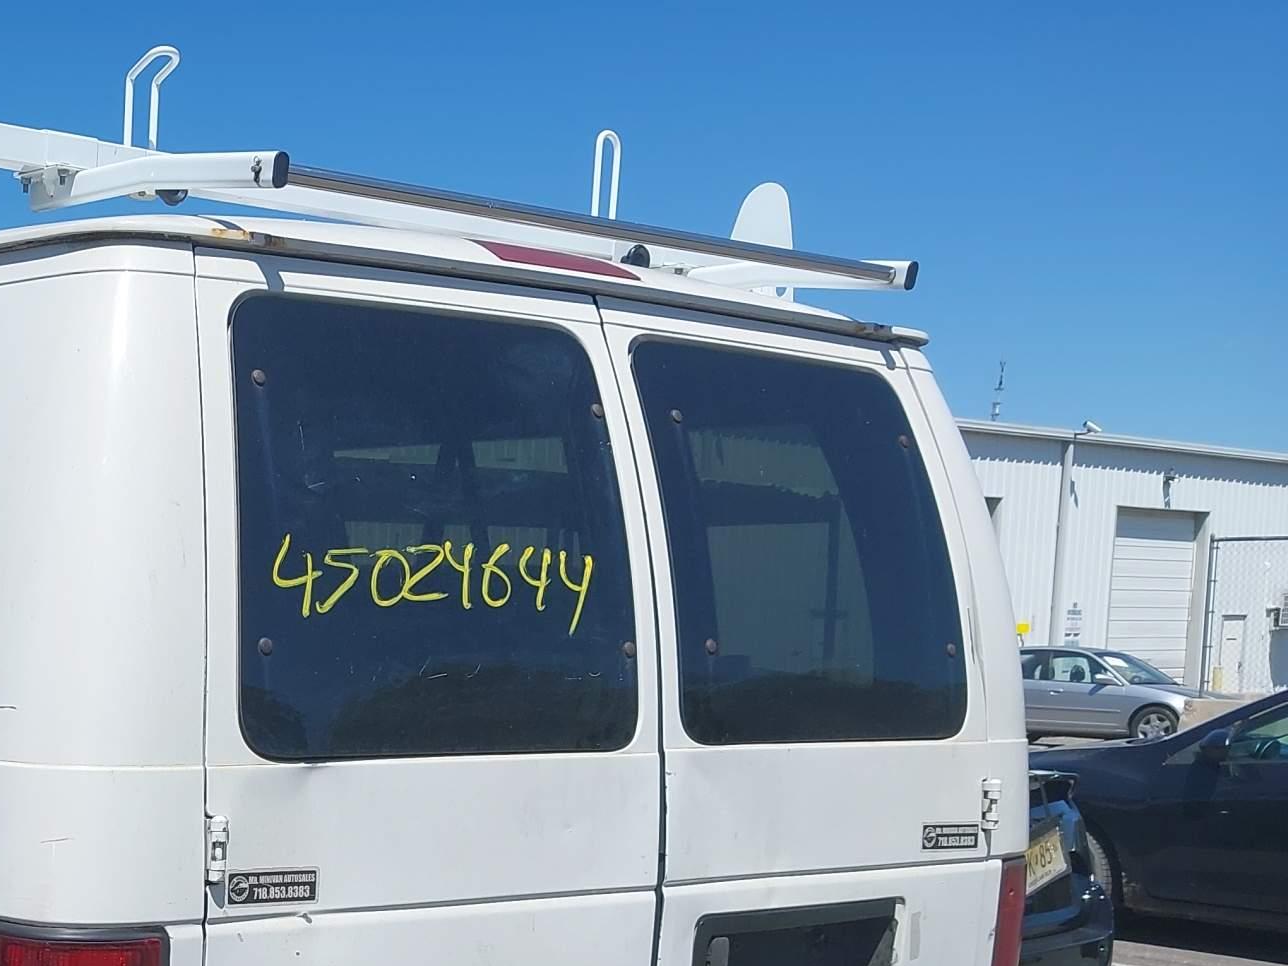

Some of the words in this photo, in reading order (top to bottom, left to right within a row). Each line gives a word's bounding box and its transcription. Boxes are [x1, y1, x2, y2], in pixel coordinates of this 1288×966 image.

[271, 533, 594, 637] 45024644
[283, 873, 316, 883] AUTOSALES
[253, 885, 310, 900] 718.853.8383
